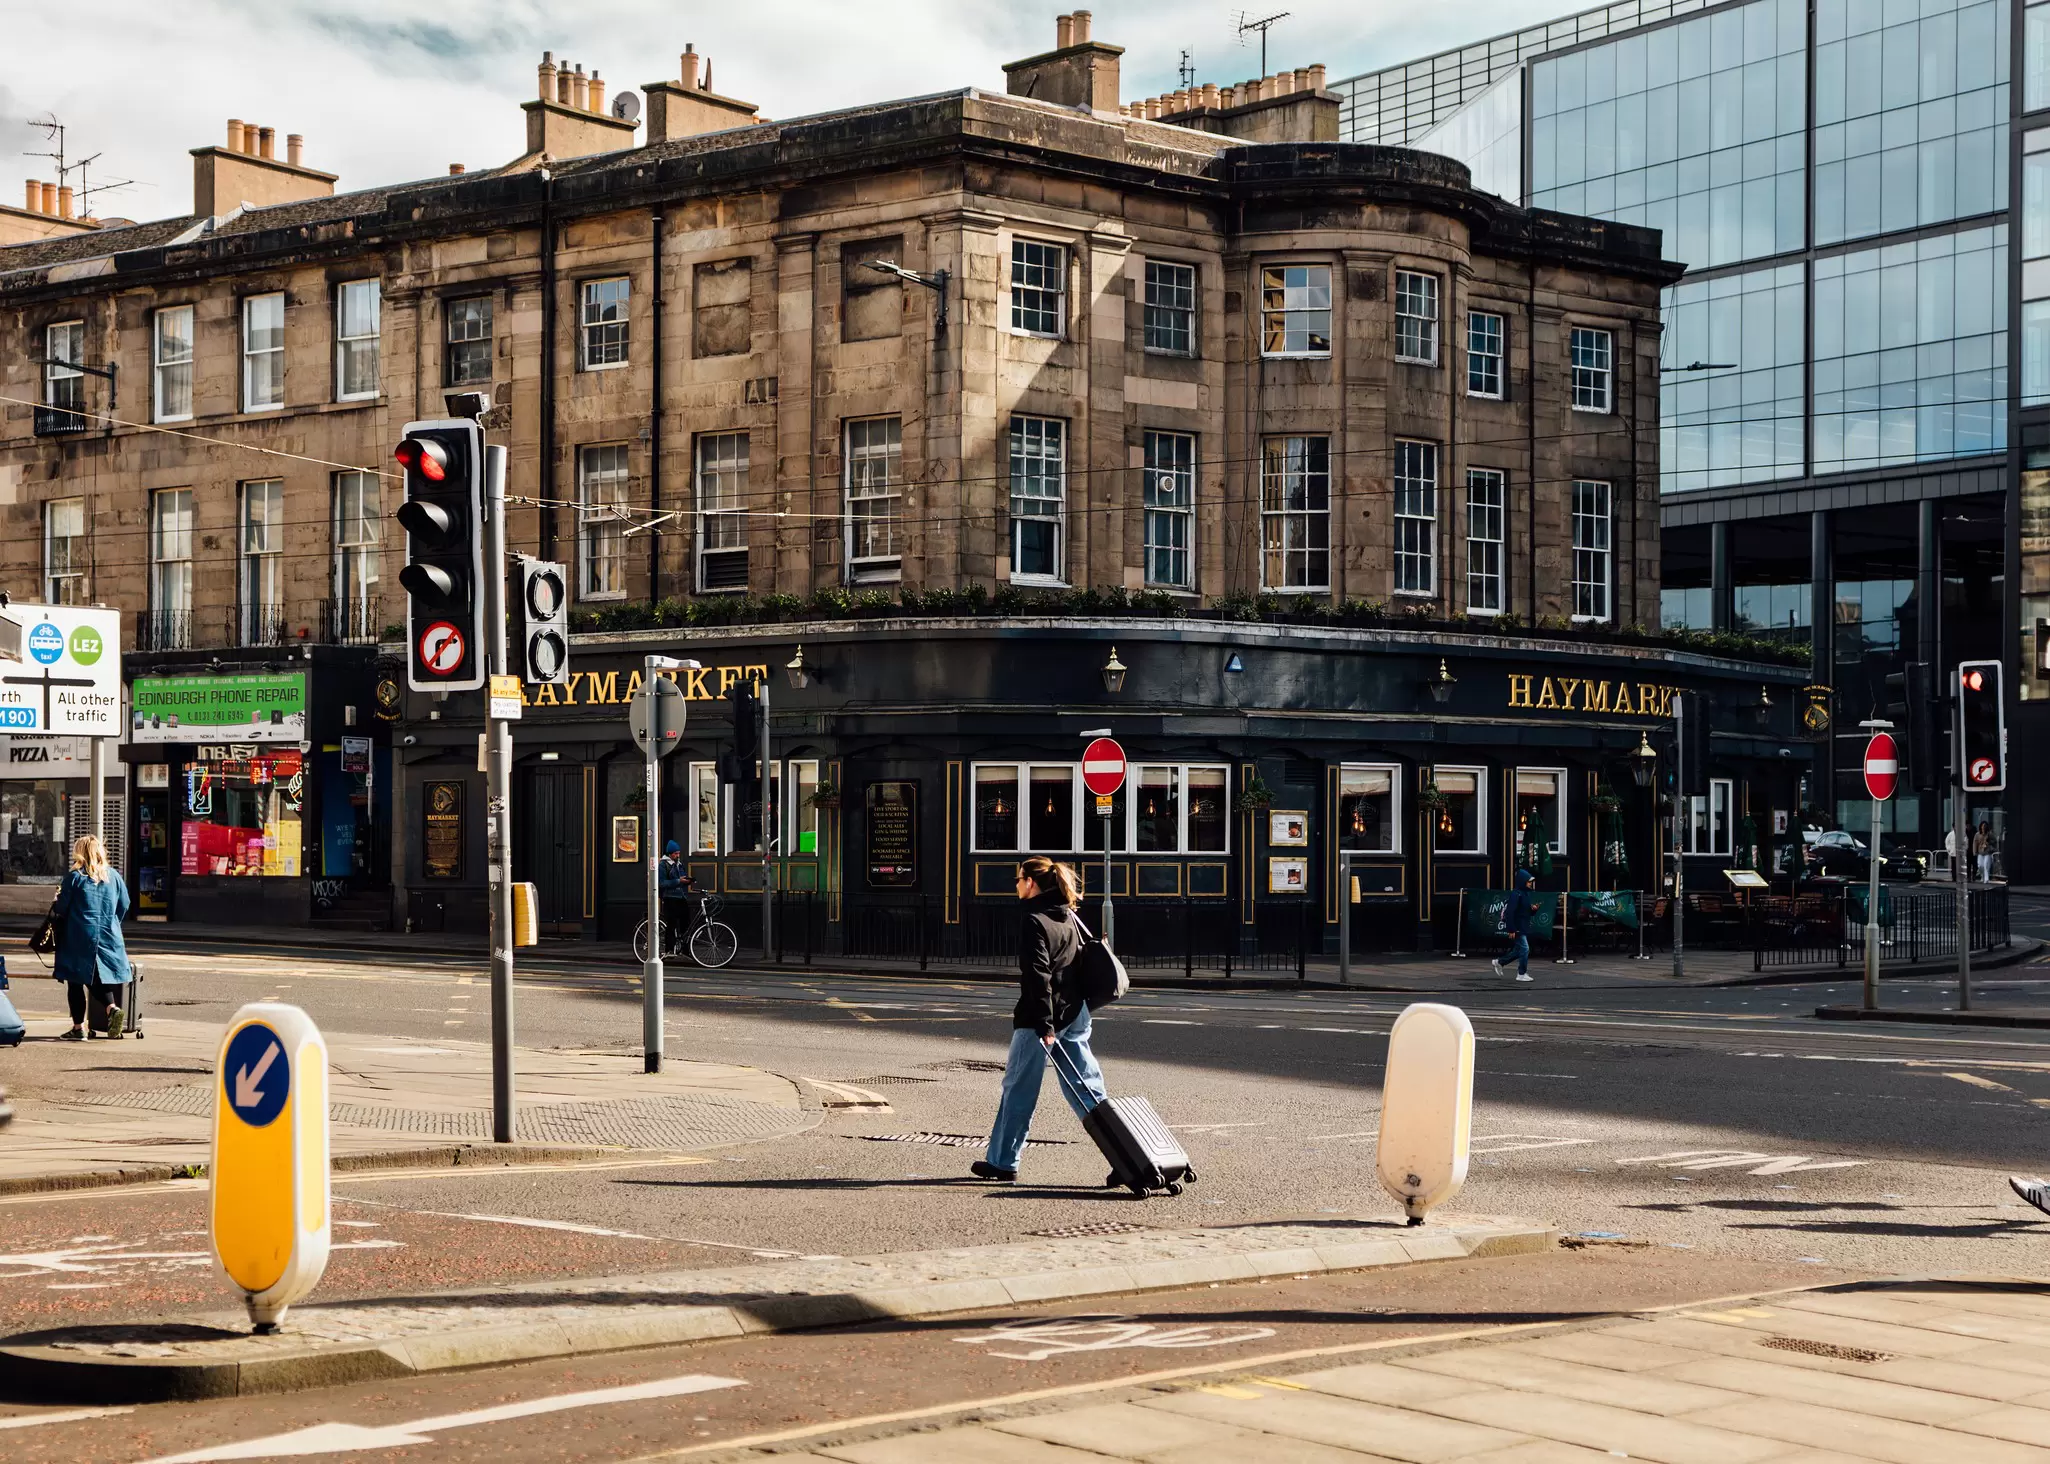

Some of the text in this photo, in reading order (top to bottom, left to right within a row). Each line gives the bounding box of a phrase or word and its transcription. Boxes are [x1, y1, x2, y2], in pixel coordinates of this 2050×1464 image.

[73, 638, 99, 653] LEZ
[40, 652, 52, 660] taxi
[521, 664, 768, 706] AYMAKET
[2, 691, 21, 703] rth
[57, 692, 115, 706] All other
[138, 687, 299, 706] EDINBURGH PHONE REPAIR
[1508, 673, 1691, 717] HAYMARK
[66, 709, 107, 722] traffic
[194, 711, 211, 721] 0131
[212, 711, 225, 721] 241
[9, 747, 49, 763] PIZZA
